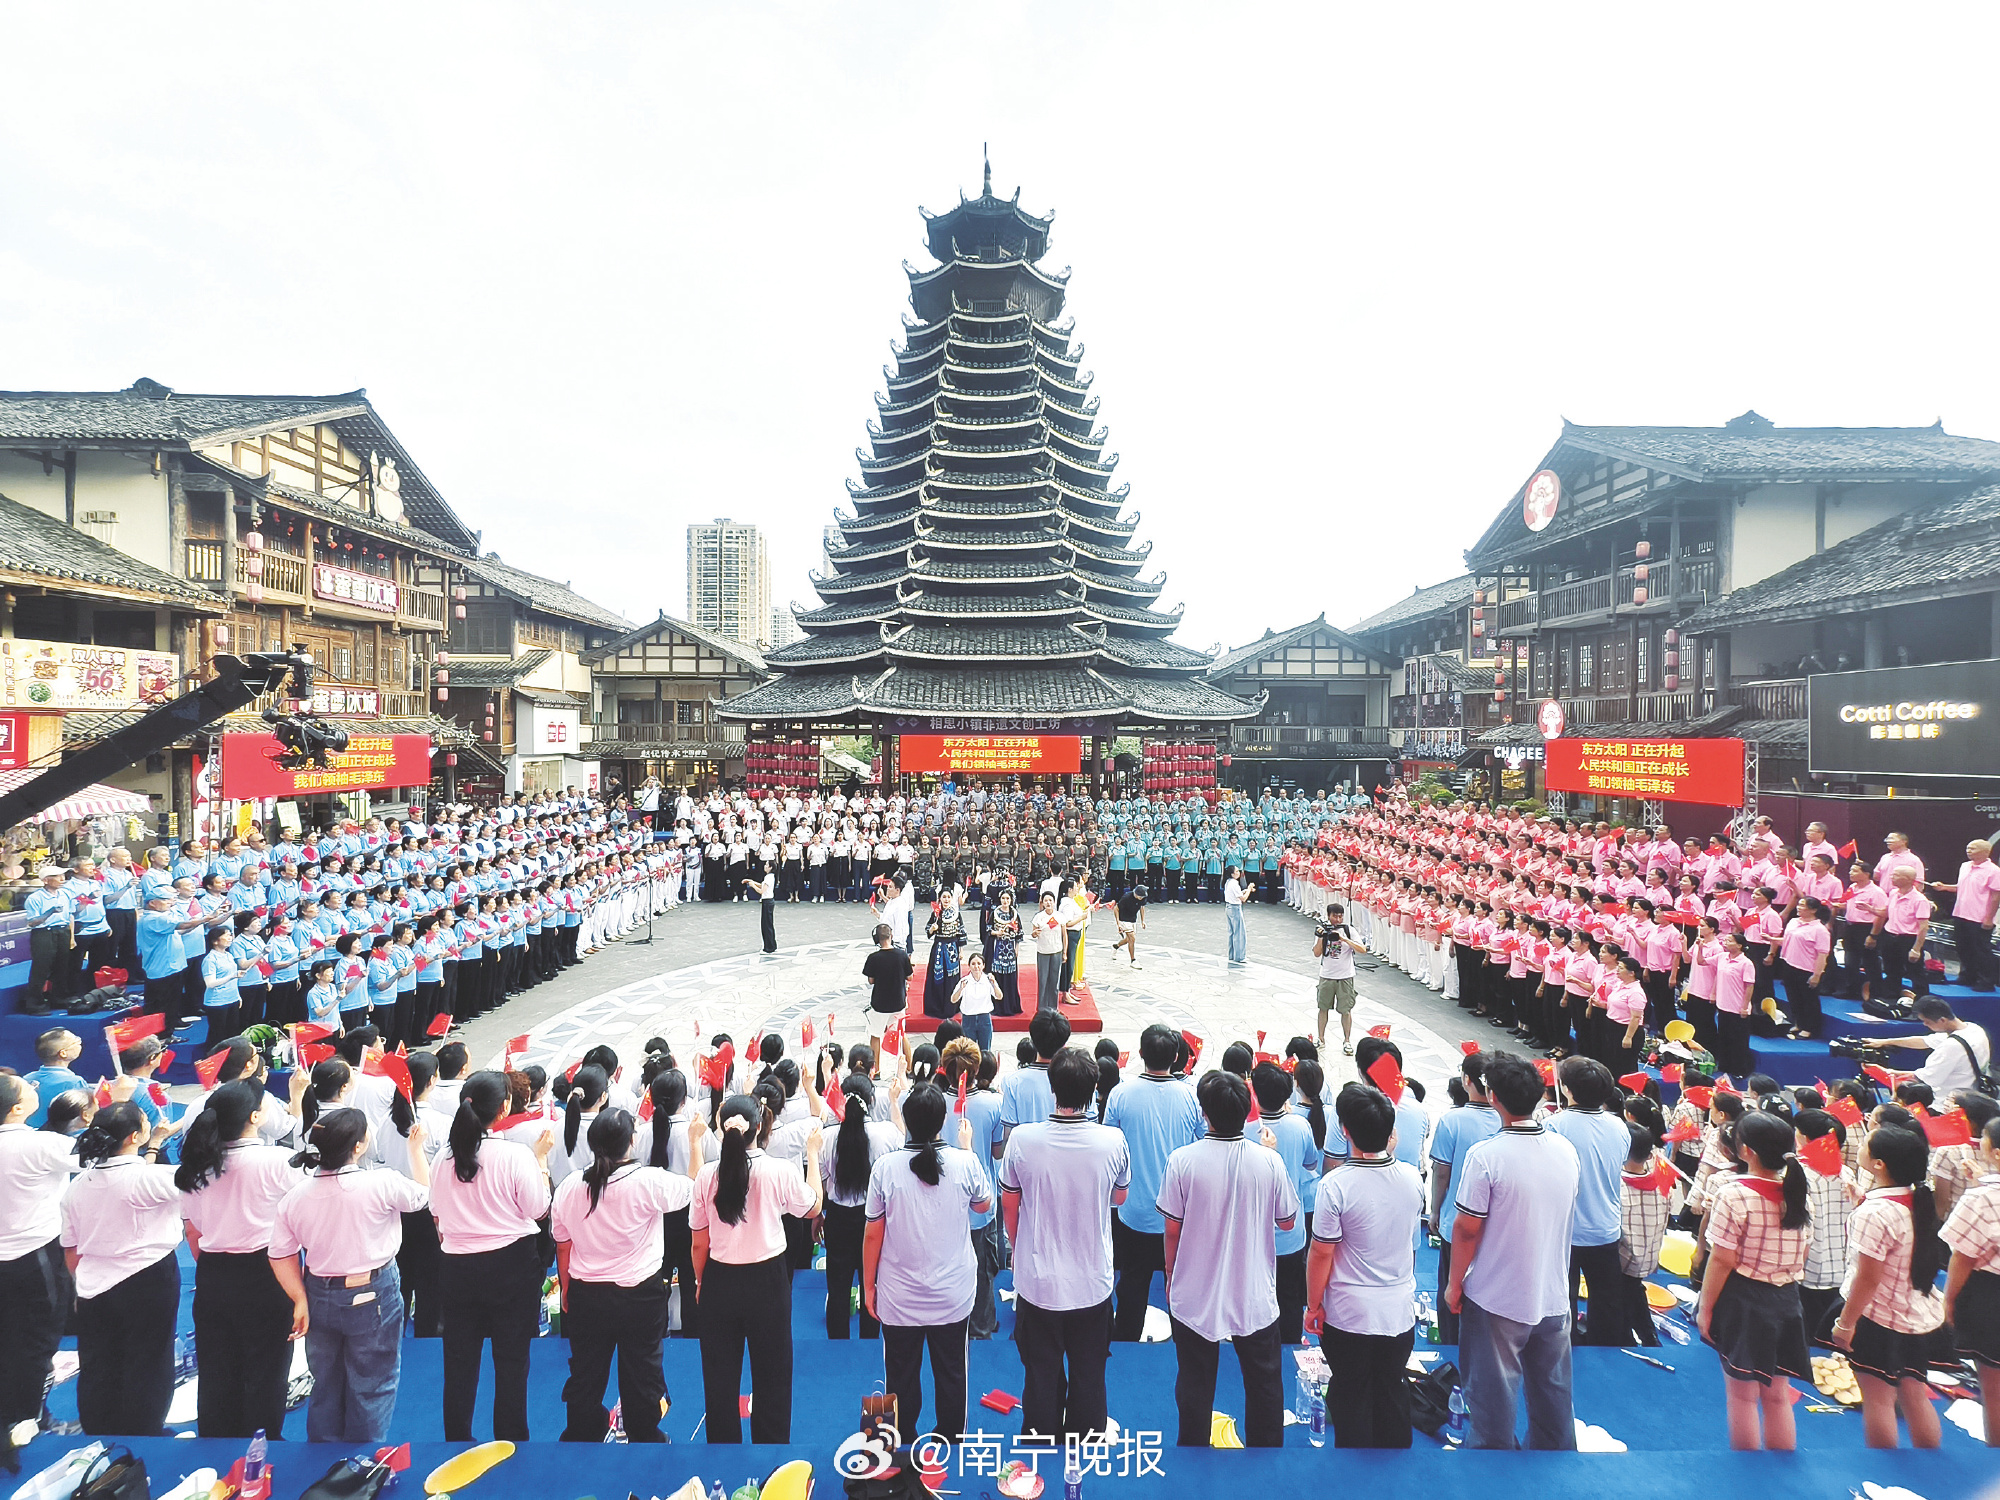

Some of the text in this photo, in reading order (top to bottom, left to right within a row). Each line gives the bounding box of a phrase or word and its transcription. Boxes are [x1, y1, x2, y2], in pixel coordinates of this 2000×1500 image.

[335, 573, 397, 607] 蜜雪冰城
[72, 648, 126, 667] 双人套餐
[86, 669, 115, 690] 56
[312, 688, 377, 714] 蜜雪冰城
[1840, 701, 1977, 723] Cotti Coffee
[930, 717, 1061, 731] 相思小镇非遗文创工坊
[943, 738, 1039, 747] 东方太阳 正在升起
[1581, 743, 1685, 758] 东方太阳 正在升起
[938, 749, 1043, 758] 人民共和国正在成长
[1493, 746, 1543, 760] CHAGEE
[949, 760, 1032, 769] 我们领袖毛泽东
[1578, 759, 1690, 777] 人民共和国正在成长
[294, 770, 386, 789] 我们领袖毛泽东
[1588, 775, 1676, 794] 我们领袖毛泽东
